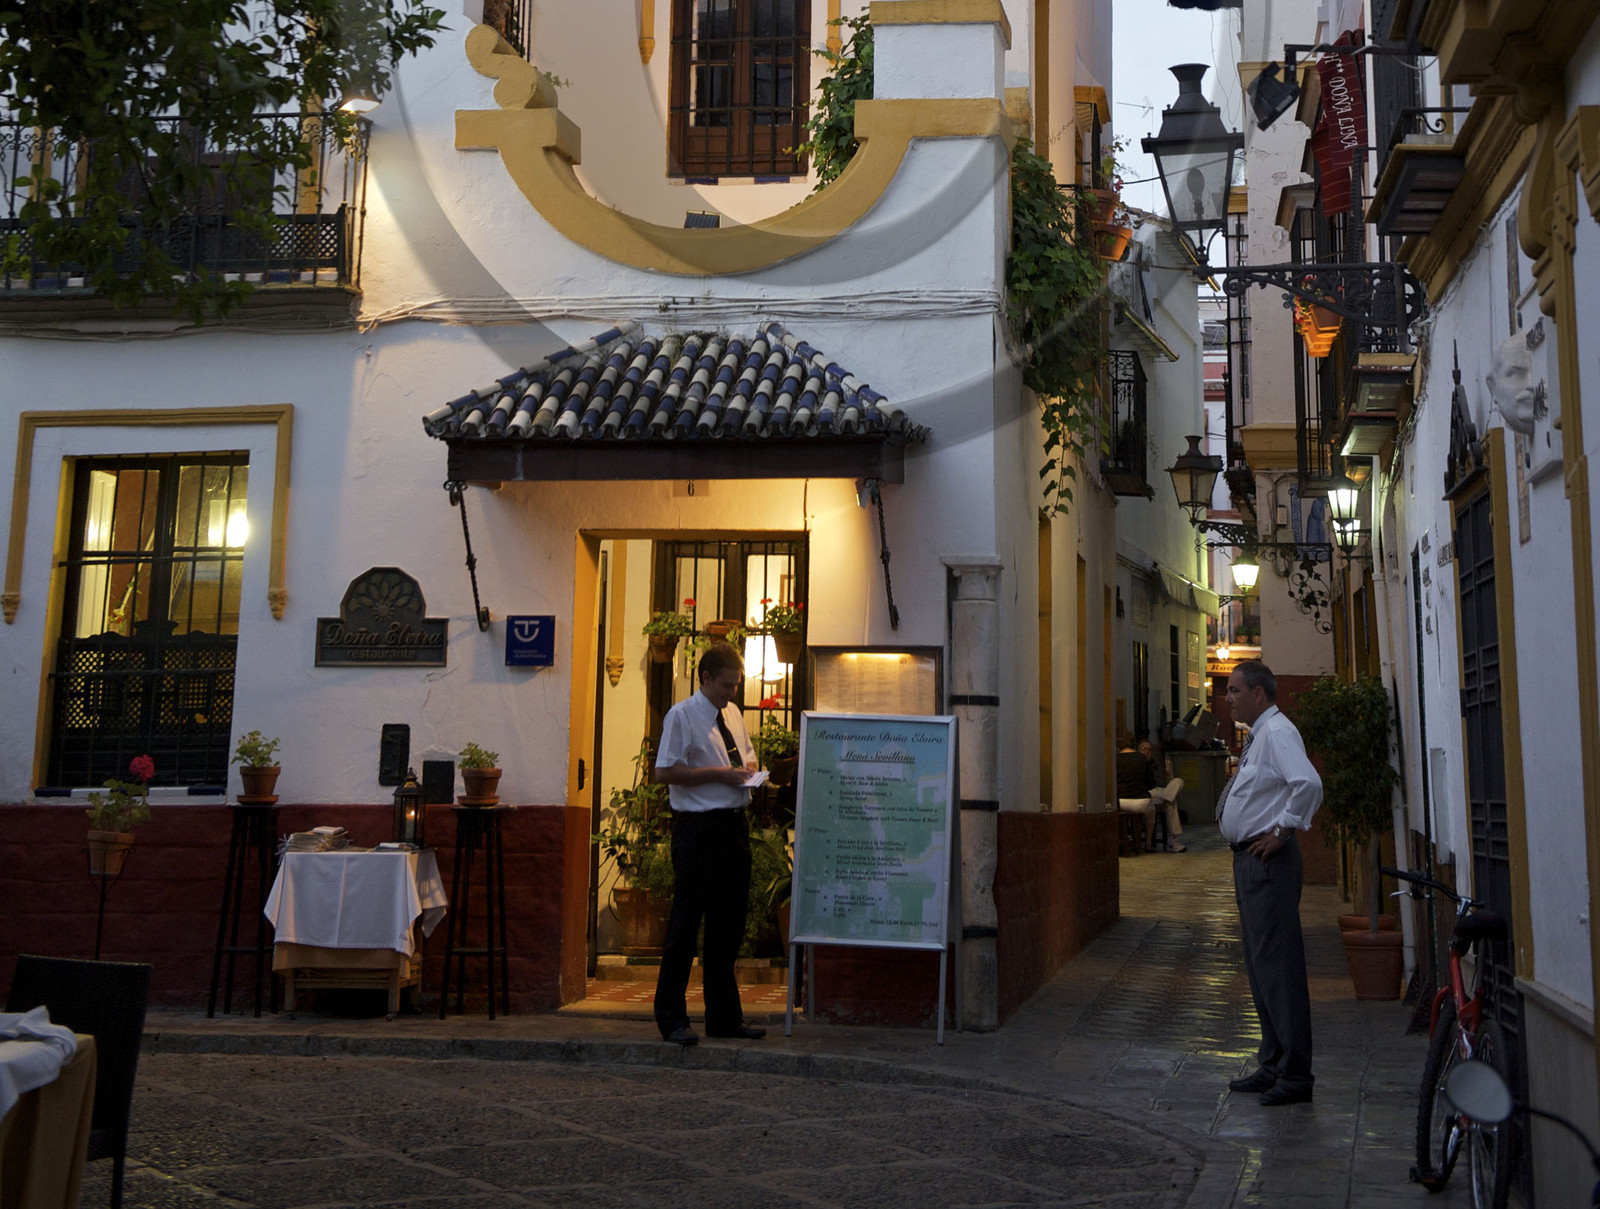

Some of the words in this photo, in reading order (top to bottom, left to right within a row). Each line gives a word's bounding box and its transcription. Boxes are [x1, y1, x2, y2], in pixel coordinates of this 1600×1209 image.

[1328, 77, 1353, 115] DOÑA
[1338, 117, 1358, 150] LINA
[687, 482, 695, 497] 6
[325, 623, 379, 645] Doña
[347, 649, 416, 659] restaurante
[814, 730, 876, 742] Restaurante
[880, 732, 908, 743] Doña
